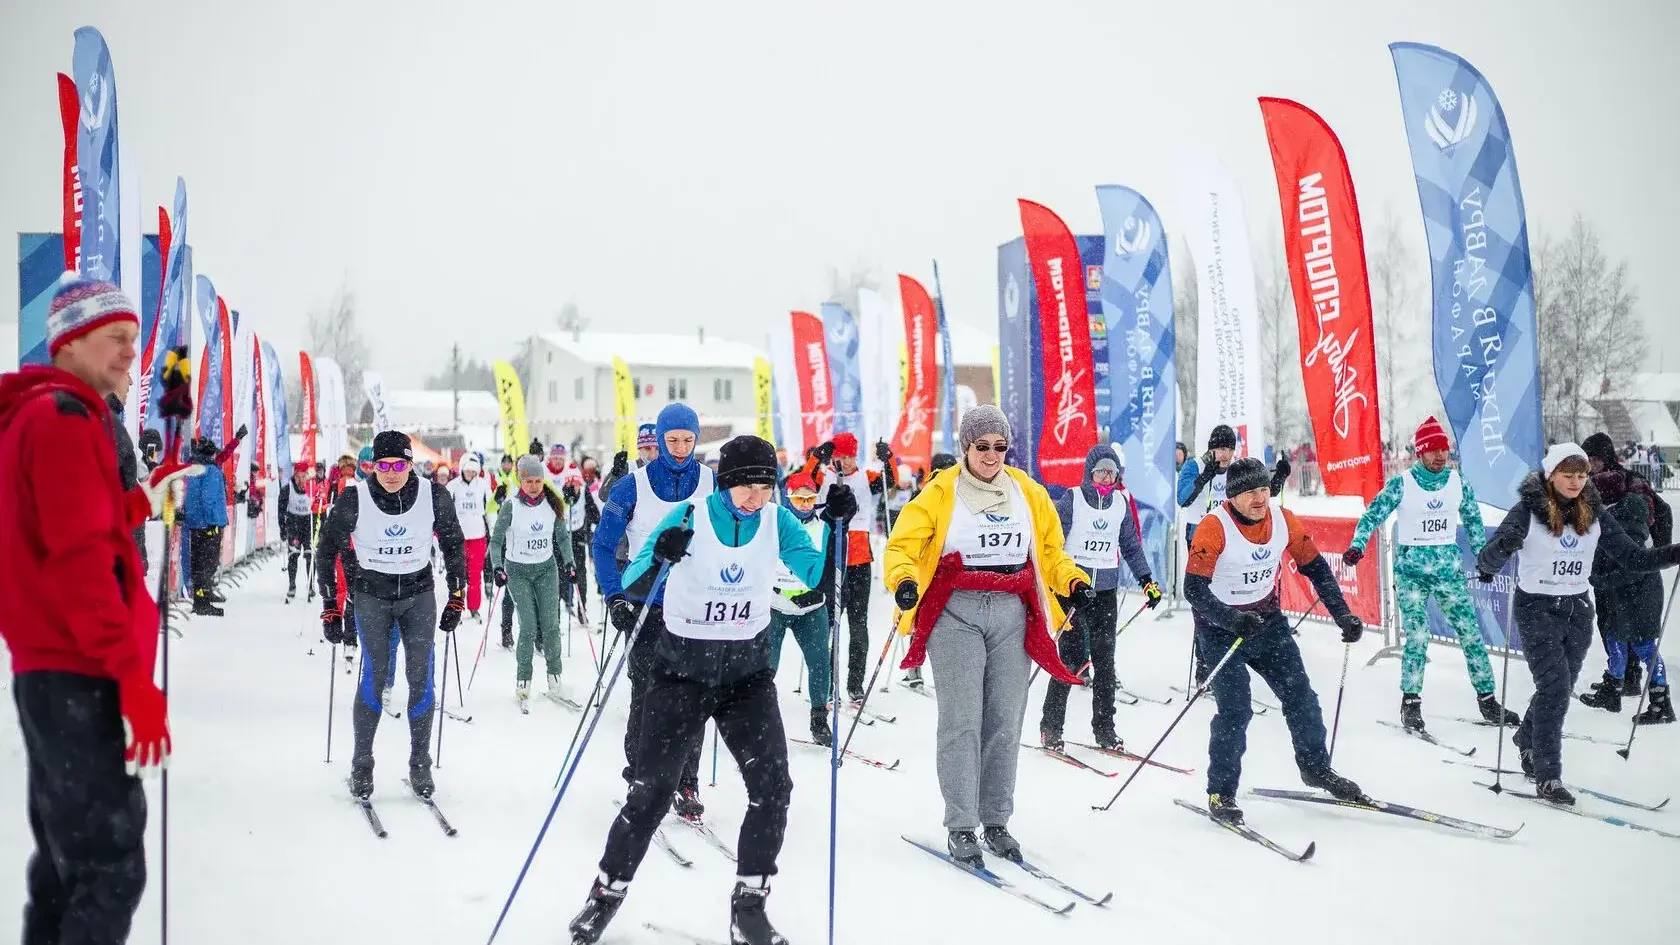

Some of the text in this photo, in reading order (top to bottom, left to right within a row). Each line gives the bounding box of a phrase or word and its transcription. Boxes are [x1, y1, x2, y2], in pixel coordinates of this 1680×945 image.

[1421, 518, 1448, 533] 1264
[526, 538, 548, 550] 1293
[977, 532, 1022, 548] 1371
[1084, 540, 1111, 552] 1277
[1242, 567, 1273, 585] 1375
[1551, 560, 1583, 576] 1349
[704, 600, 752, 622] 1314
